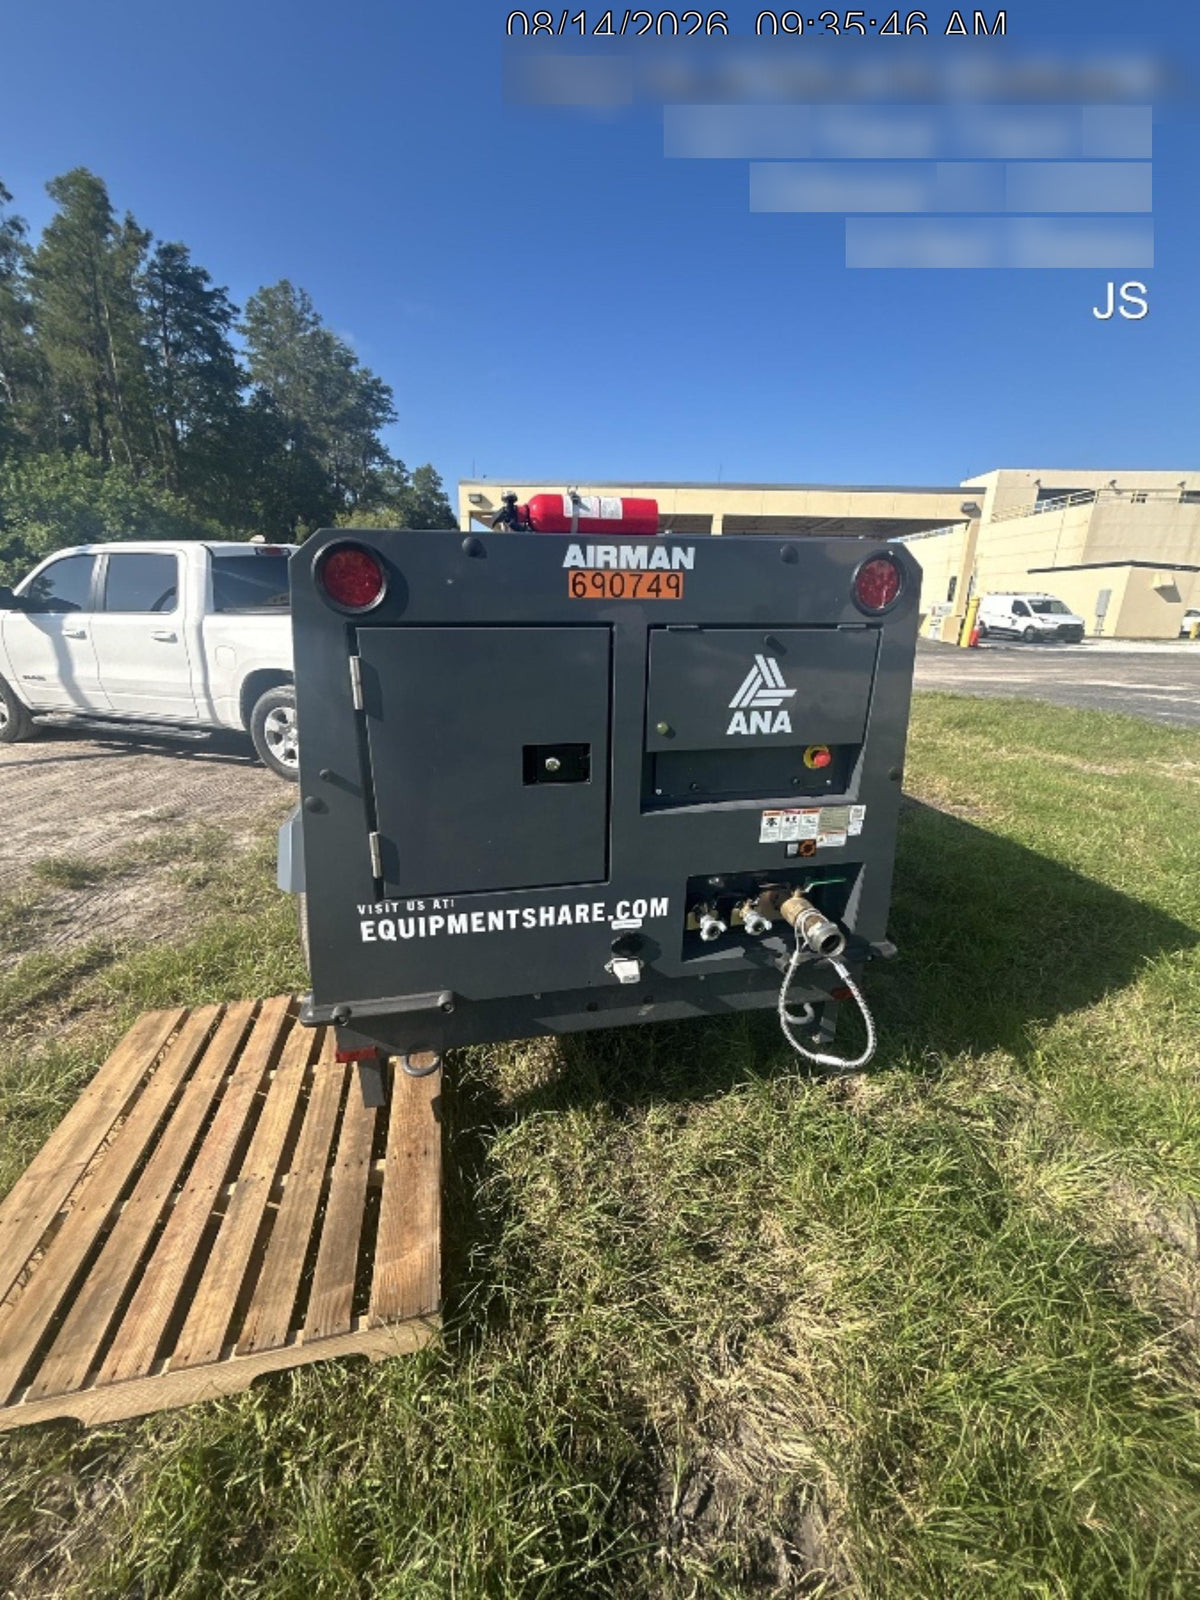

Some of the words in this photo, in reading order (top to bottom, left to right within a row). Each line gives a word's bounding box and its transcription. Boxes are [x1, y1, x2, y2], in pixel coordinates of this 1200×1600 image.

[562, 543, 695, 569] AIRMAN
[571, 573, 681, 598] 690749
[726, 710, 792, 735] ANA
[357, 902, 399, 915] VISIT
[406, 900, 426, 911] US
[360, 897, 669, 942] EQUIPMENTSHARE.COM
